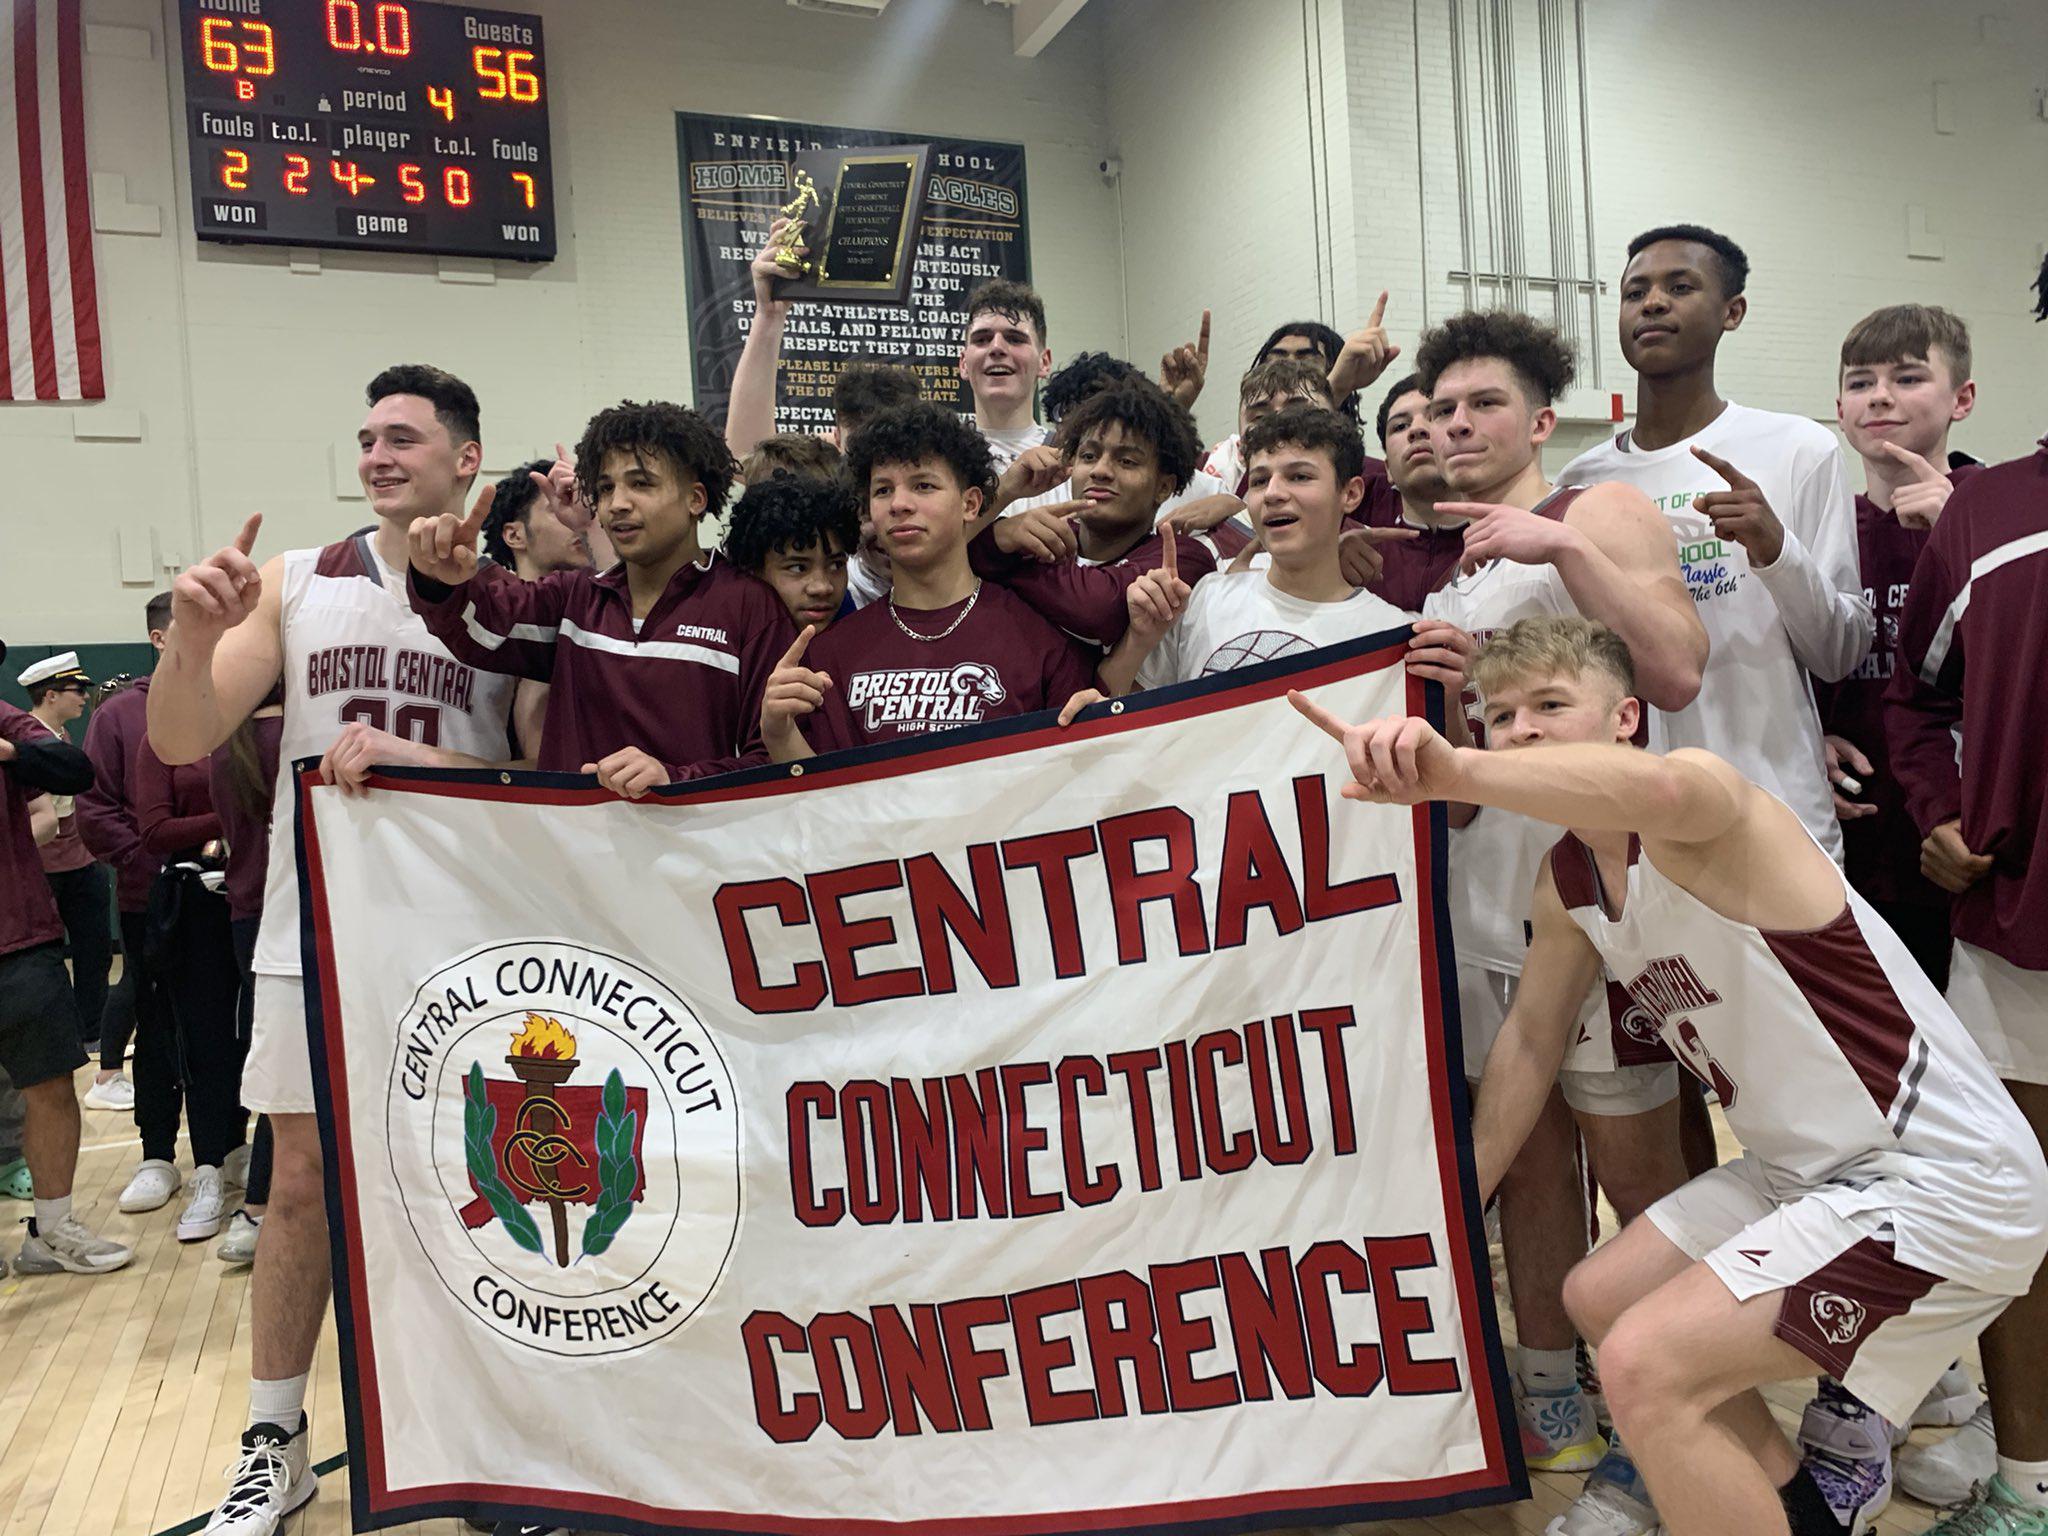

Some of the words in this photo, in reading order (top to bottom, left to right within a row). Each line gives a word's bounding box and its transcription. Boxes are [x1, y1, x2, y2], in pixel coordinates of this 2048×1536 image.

[327, 0, 410, 55] 0.0
[465, 16, 533, 45] Guests
[203, 18, 275, 75] 63
[475, 46, 539, 102] 56
[343, 89, 406, 112] period
[428, 86, 453, 121] 4
[203, 113, 254, 138] fouls
[271, 121, 317, 143] t.o.l.
[343, 124, 410, 150] player
[435, 137, 476, 157] t.o.l.
[492, 138, 538, 163] fouls
[222, 150, 248, 189] 2
[284, 154, 309, 193] 2
[938, 154, 995, 171] HOOL
[399, 164, 424, 202] 5
[445, 168, 470, 205] 0
[695, 164, 786, 189] HOME
[511, 172, 534, 208] 7
[927, 177, 1015, 214] AGLES
[213, 204, 257, 224] won
[357, 214, 408, 235] game
[698, 208, 765, 224] BELIEVES
[502, 224, 540, 242] won
[838, 236, 889, 247] CHAMPIONS
[927, 226, 1013, 242] EXPECTATION
[950, 245, 981, 259] ACT
[912, 276, 924, 289] D
[927, 277, 965, 292] YOU.
[911, 293, 945, 307] THE
[918, 310, 970, 325] COACH
[840, 322, 876, 337] AND
[880, 325, 948, 340] FELLOW
[783, 336, 860, 354] RESPECT
[865, 340, 911, 356] THEY
[915, 343, 966, 358] DESER
[777, 359, 830, 372] PLEASE
[834, 361, 849, 373] LE
[787, 372, 815, 384] THE
[819, 373, 837, 385] CO
[933, 378, 960, 390] AND
[785, 385, 814, 397] THE
[817, 386, 835, 398] OF
[919, 390, 960, 402] CIATE.
[1672, 493, 1692, 509] OF
[1678, 540, 1731, 564] HOOL
[675, 623, 728, 645] CENTRAL
[307, 645, 388, 698] BRISTOL
[394, 648, 475, 716] CENTRAL
[849, 670, 951, 708] BRISTOL
[866, 695, 980, 730] CENTRAL
[897, 721, 925, 733] HIGH
[928, 723, 968, 733] SCH
[712, 773, 1402, 1015] CENTRAL
[400, 974, 489, 1102] CENTRAL
[496, 956, 723, 1116] CONNECTICUT
[785, 1004, 1358, 1228] CONNECTICUT
[472, 1273, 682, 1344] CONFERENCE
[740, 1232, 1462, 1444] CONFERENCE
